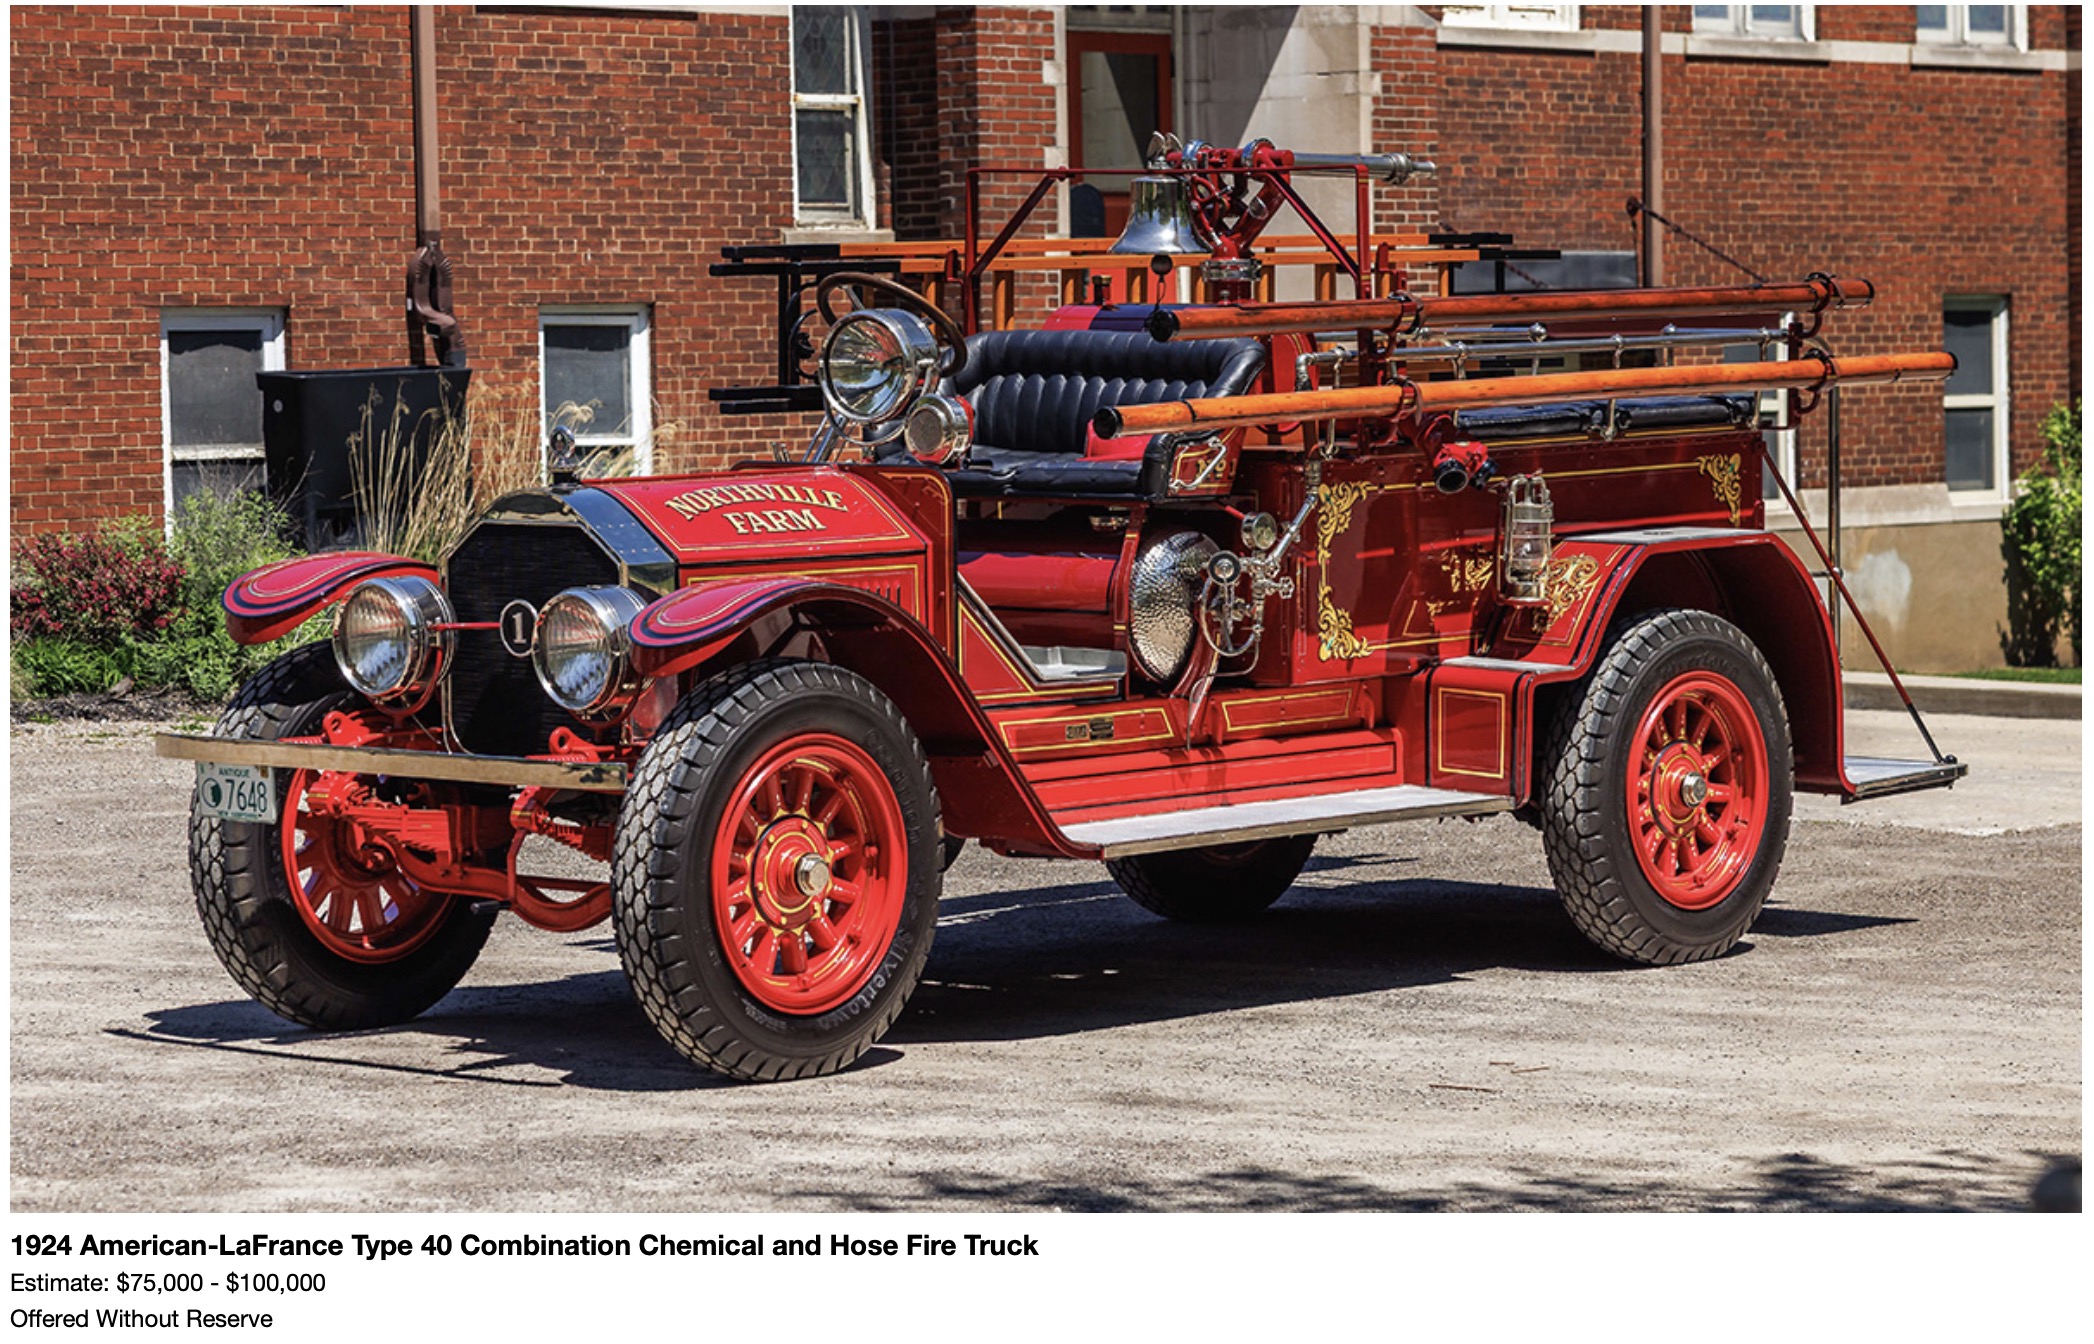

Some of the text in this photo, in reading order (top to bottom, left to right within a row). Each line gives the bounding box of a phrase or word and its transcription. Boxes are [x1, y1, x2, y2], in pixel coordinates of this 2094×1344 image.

[664, 483, 849, 521] NORTHVILLE
[722, 508, 827, 535] FARM
[512, 612, 527, 645] 1
[225, 778, 268, 813] 7648
